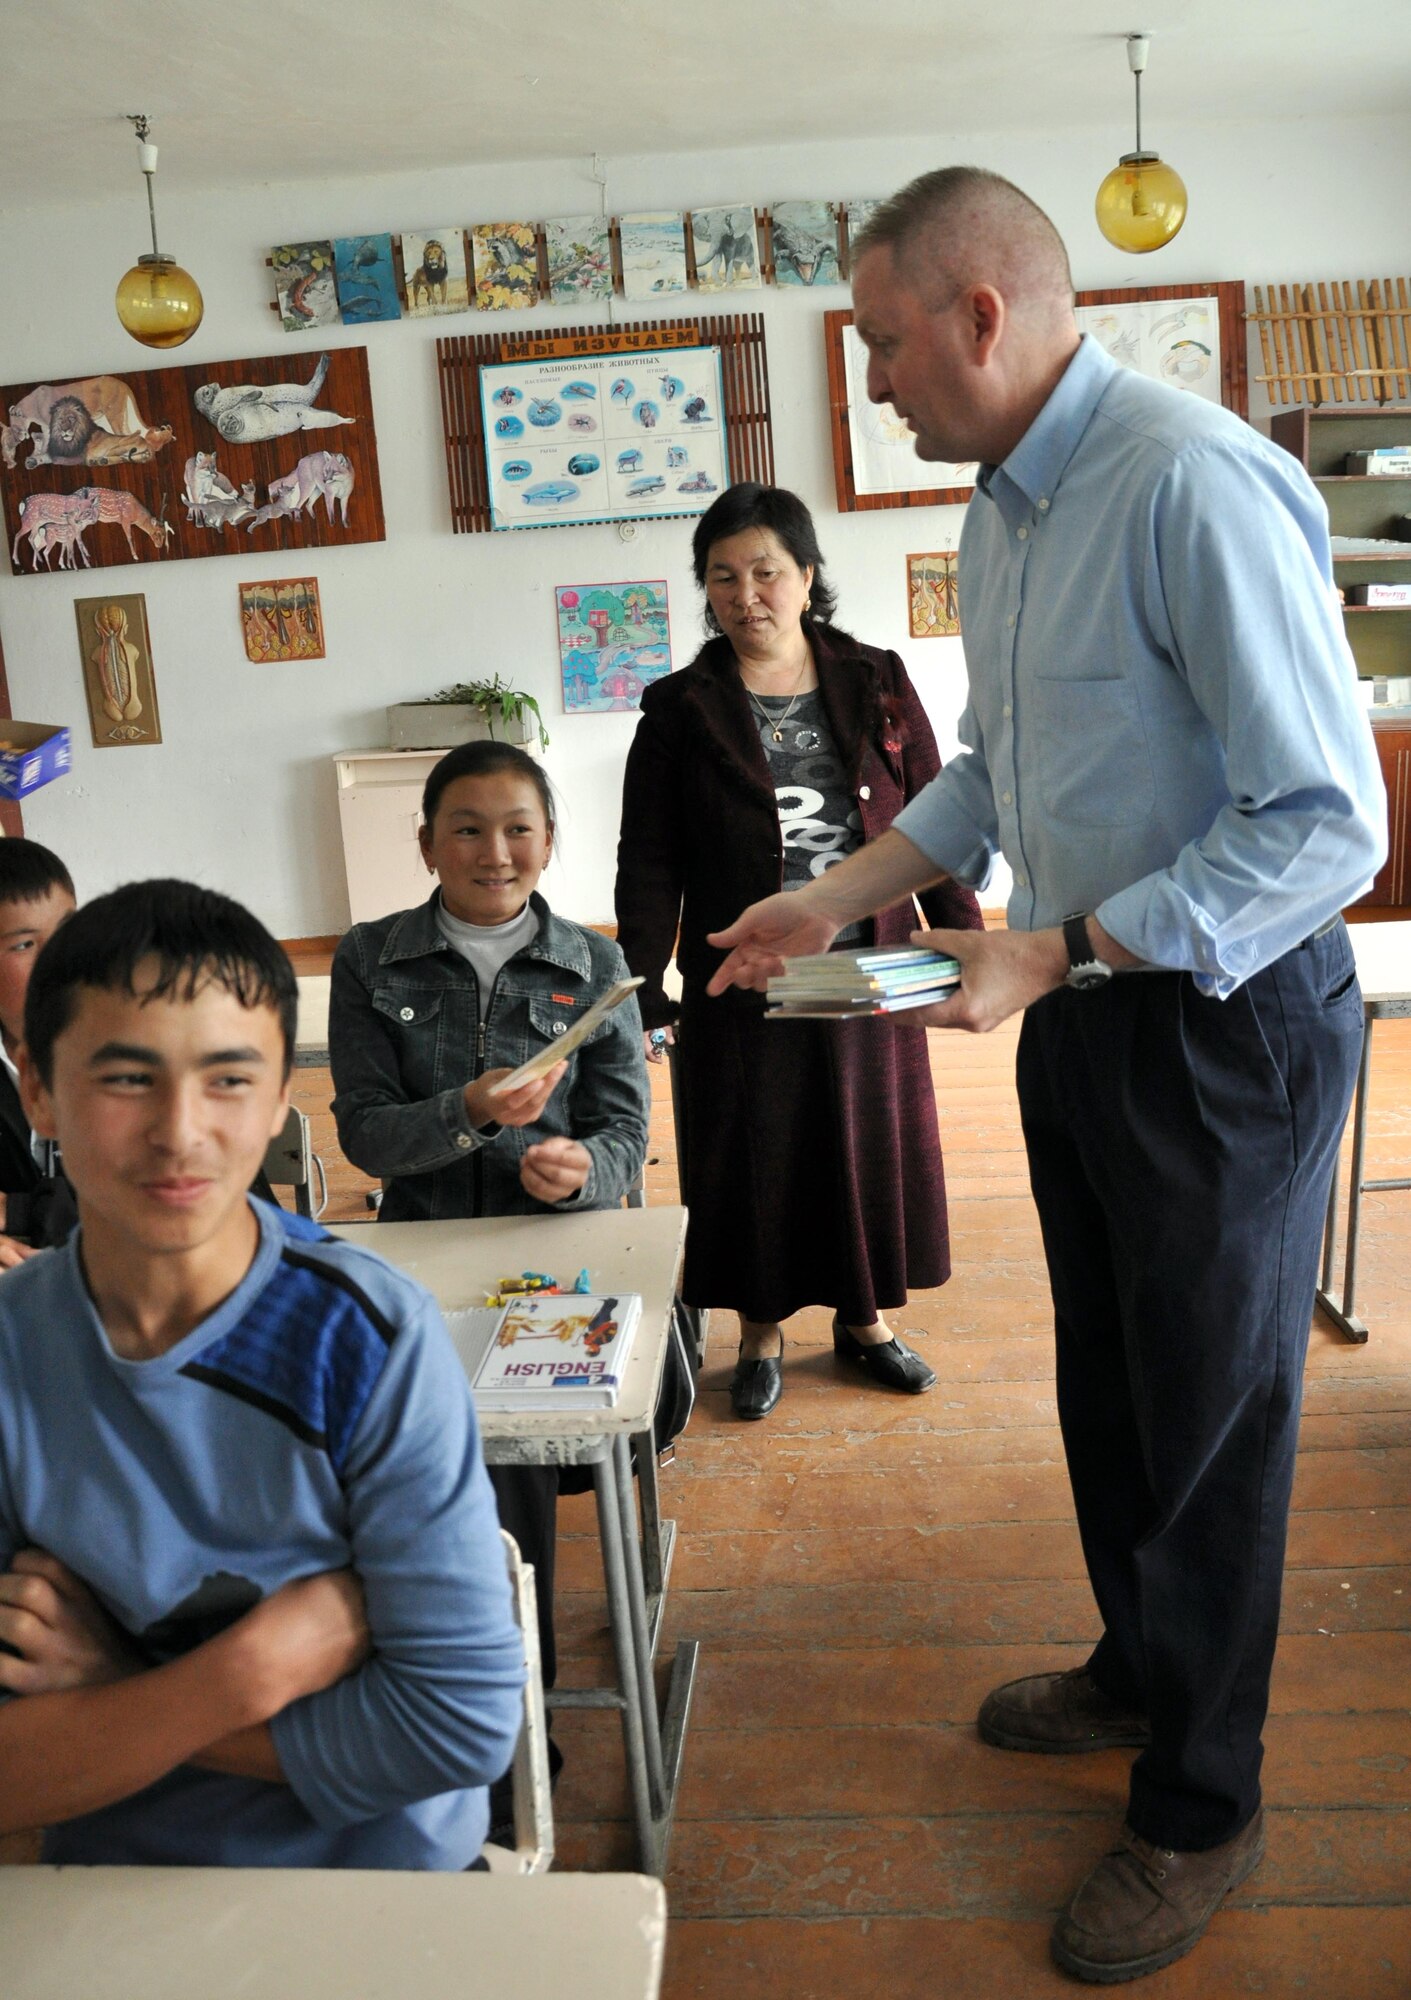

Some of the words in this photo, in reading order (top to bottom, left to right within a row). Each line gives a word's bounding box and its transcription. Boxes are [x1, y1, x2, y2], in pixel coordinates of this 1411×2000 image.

[573, 330, 694, 352] ИЗУЧАЕМ
[539, 361, 605, 374] РАЗНООБРАЗИЕ
[608, 356, 660, 368] ЖИВОТНЫХ
[503, 1361, 607, 1376] ENGLISH
